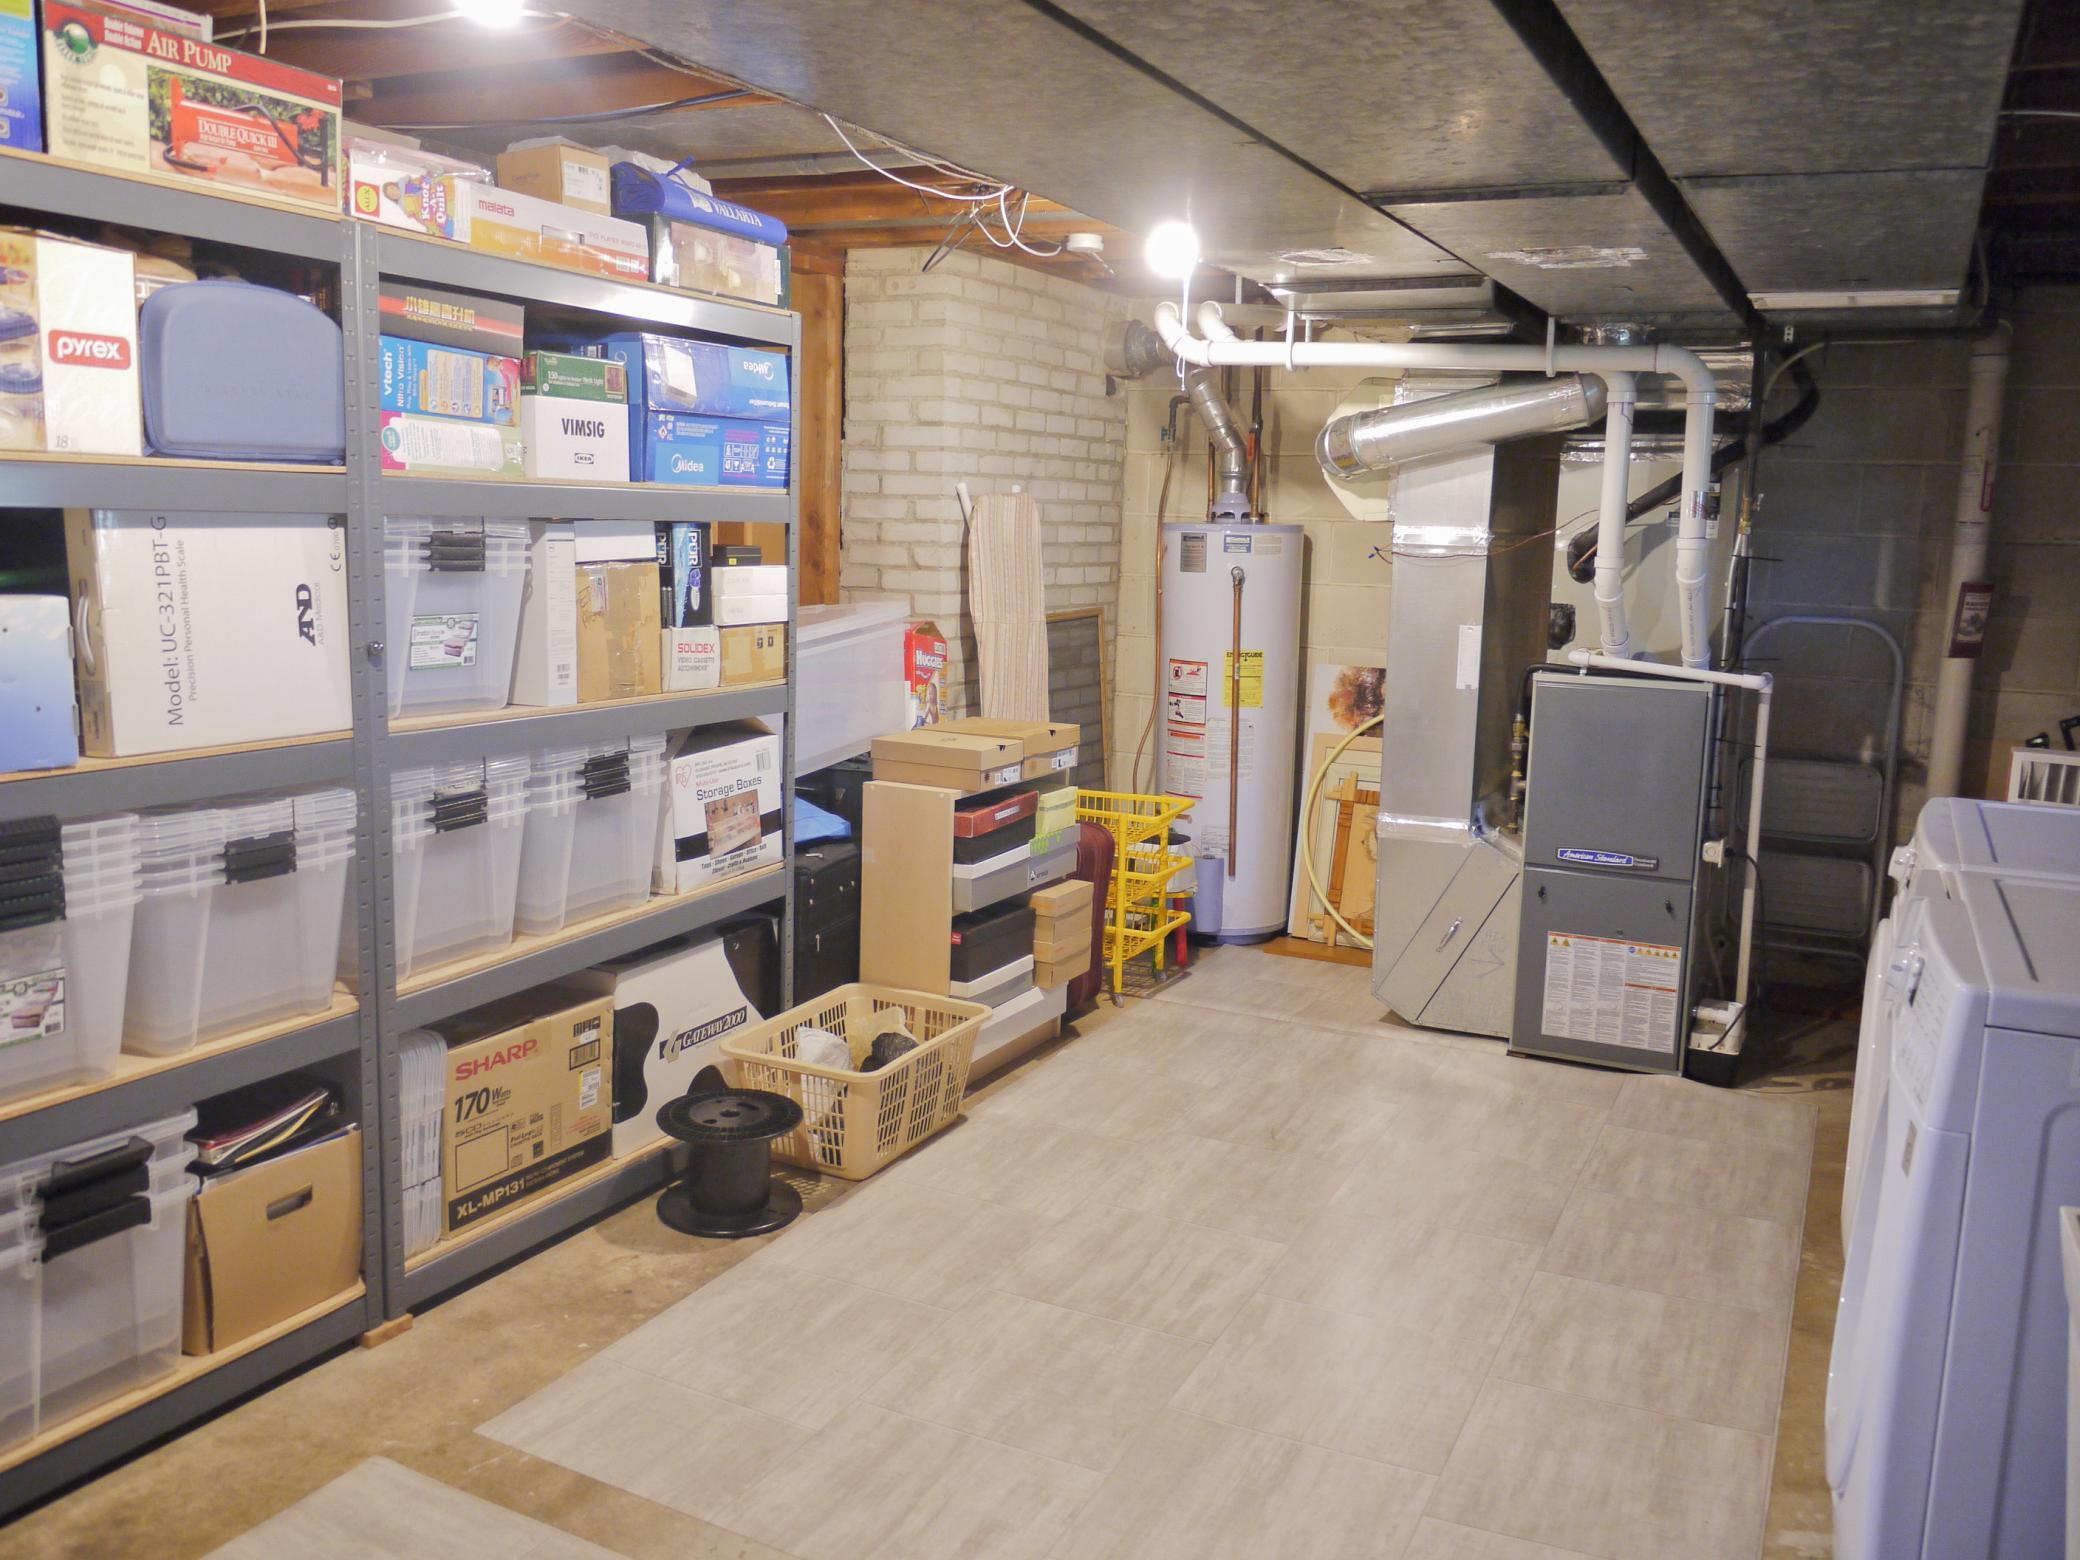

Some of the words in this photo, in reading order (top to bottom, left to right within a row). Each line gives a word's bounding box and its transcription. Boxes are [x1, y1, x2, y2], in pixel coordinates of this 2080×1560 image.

[147, 31, 179, 60] AIR
[183, 39, 232, 73] PUMP
[199, 120, 236, 137] DOUBLE
[237, 125, 267, 146] QUICK
[57, 337, 121, 361] pyrex
[55, 435, 69, 449] 18
[561, 418, 605, 438] VIMSIG
[674, 455, 704, 473] Midea
[176, 539, 187, 568] Scale
[151, 515, 178, 654] UC-321PBT-G
[179, 569, 190, 605] Health
[181, 599, 193, 652] Personal
[295, 583, 316, 647] AND
[677, 643, 715, 653] SOLIDEX
[163, 656, 184, 726] Model:
[184, 654, 197, 702] Precision
[696, 782, 734, 801] Storage
[736, 776, 762, 791] Boxes
[1564, 850, 1595, 862] American
[1595, 853, 1628, 864] Standard
[455, 1039, 538, 1081] SHARP
[455, 1087, 490, 1123] 170
[457, 1178, 525, 1220] XL-MP131
